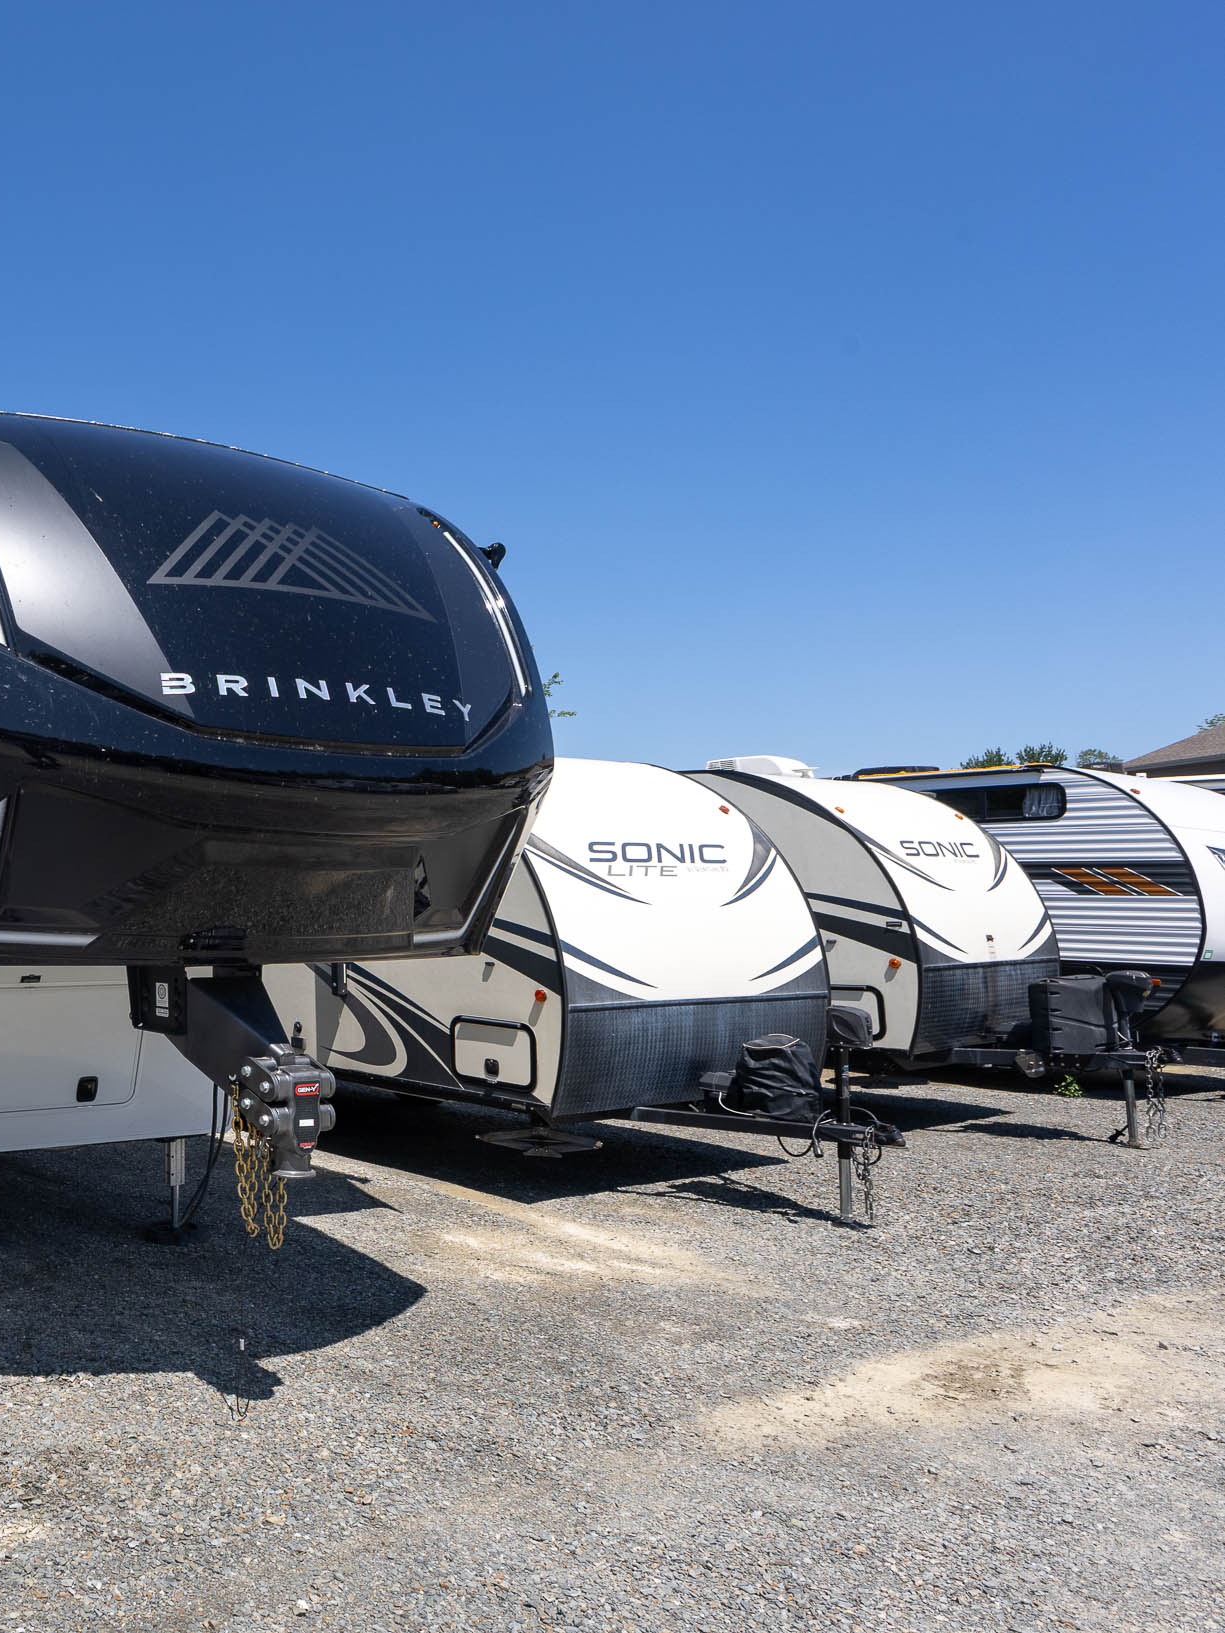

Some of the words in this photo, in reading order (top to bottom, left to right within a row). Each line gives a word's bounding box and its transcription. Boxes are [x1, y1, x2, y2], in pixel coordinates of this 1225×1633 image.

[160, 672, 472, 722] BRINKLEY
[587, 841, 728, 864] SONIC
[899, 840, 980, 858] SONIC
[607, 864, 678, 877] LITE
[297, 1083, 320, 1093] GEN-Y
